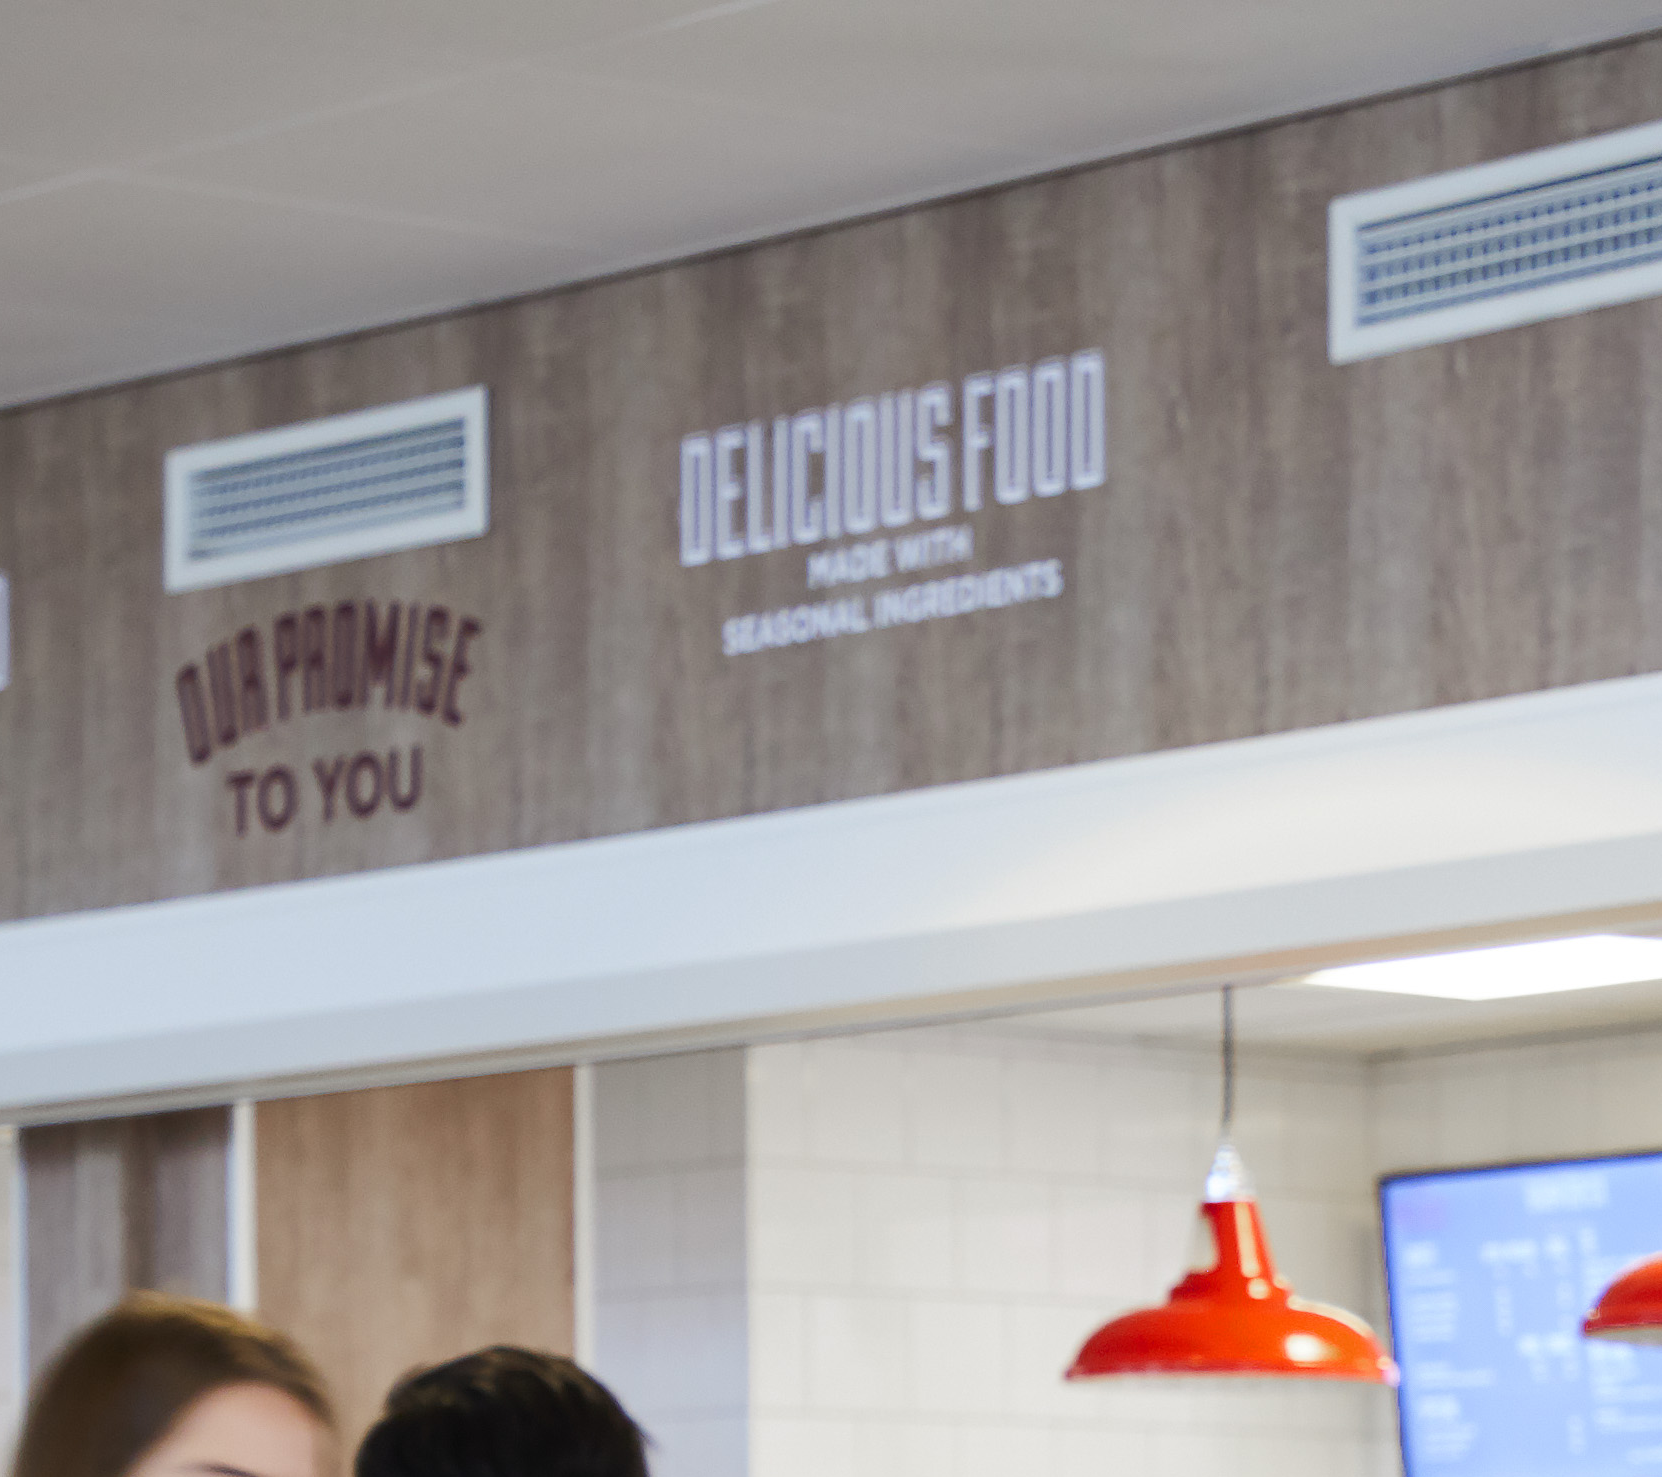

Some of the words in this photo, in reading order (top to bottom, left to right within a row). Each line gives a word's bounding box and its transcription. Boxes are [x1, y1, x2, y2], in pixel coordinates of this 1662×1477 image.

[680, 380, 951, 567] DELICIOUS
[963, 348, 1106, 511] FOOD
[807, 540, 888, 589] MADE
[894, 523, 973, 572] WITH
[723, 602, 869, 656] SEASONAL
[872, 559, 1063, 628] INGREDIENTS
[176, 624, 268, 766] OUR
[275, 599, 482, 726] PROMISE
[226, 764, 298, 837] TO
[312, 740, 423, 826] YOU
